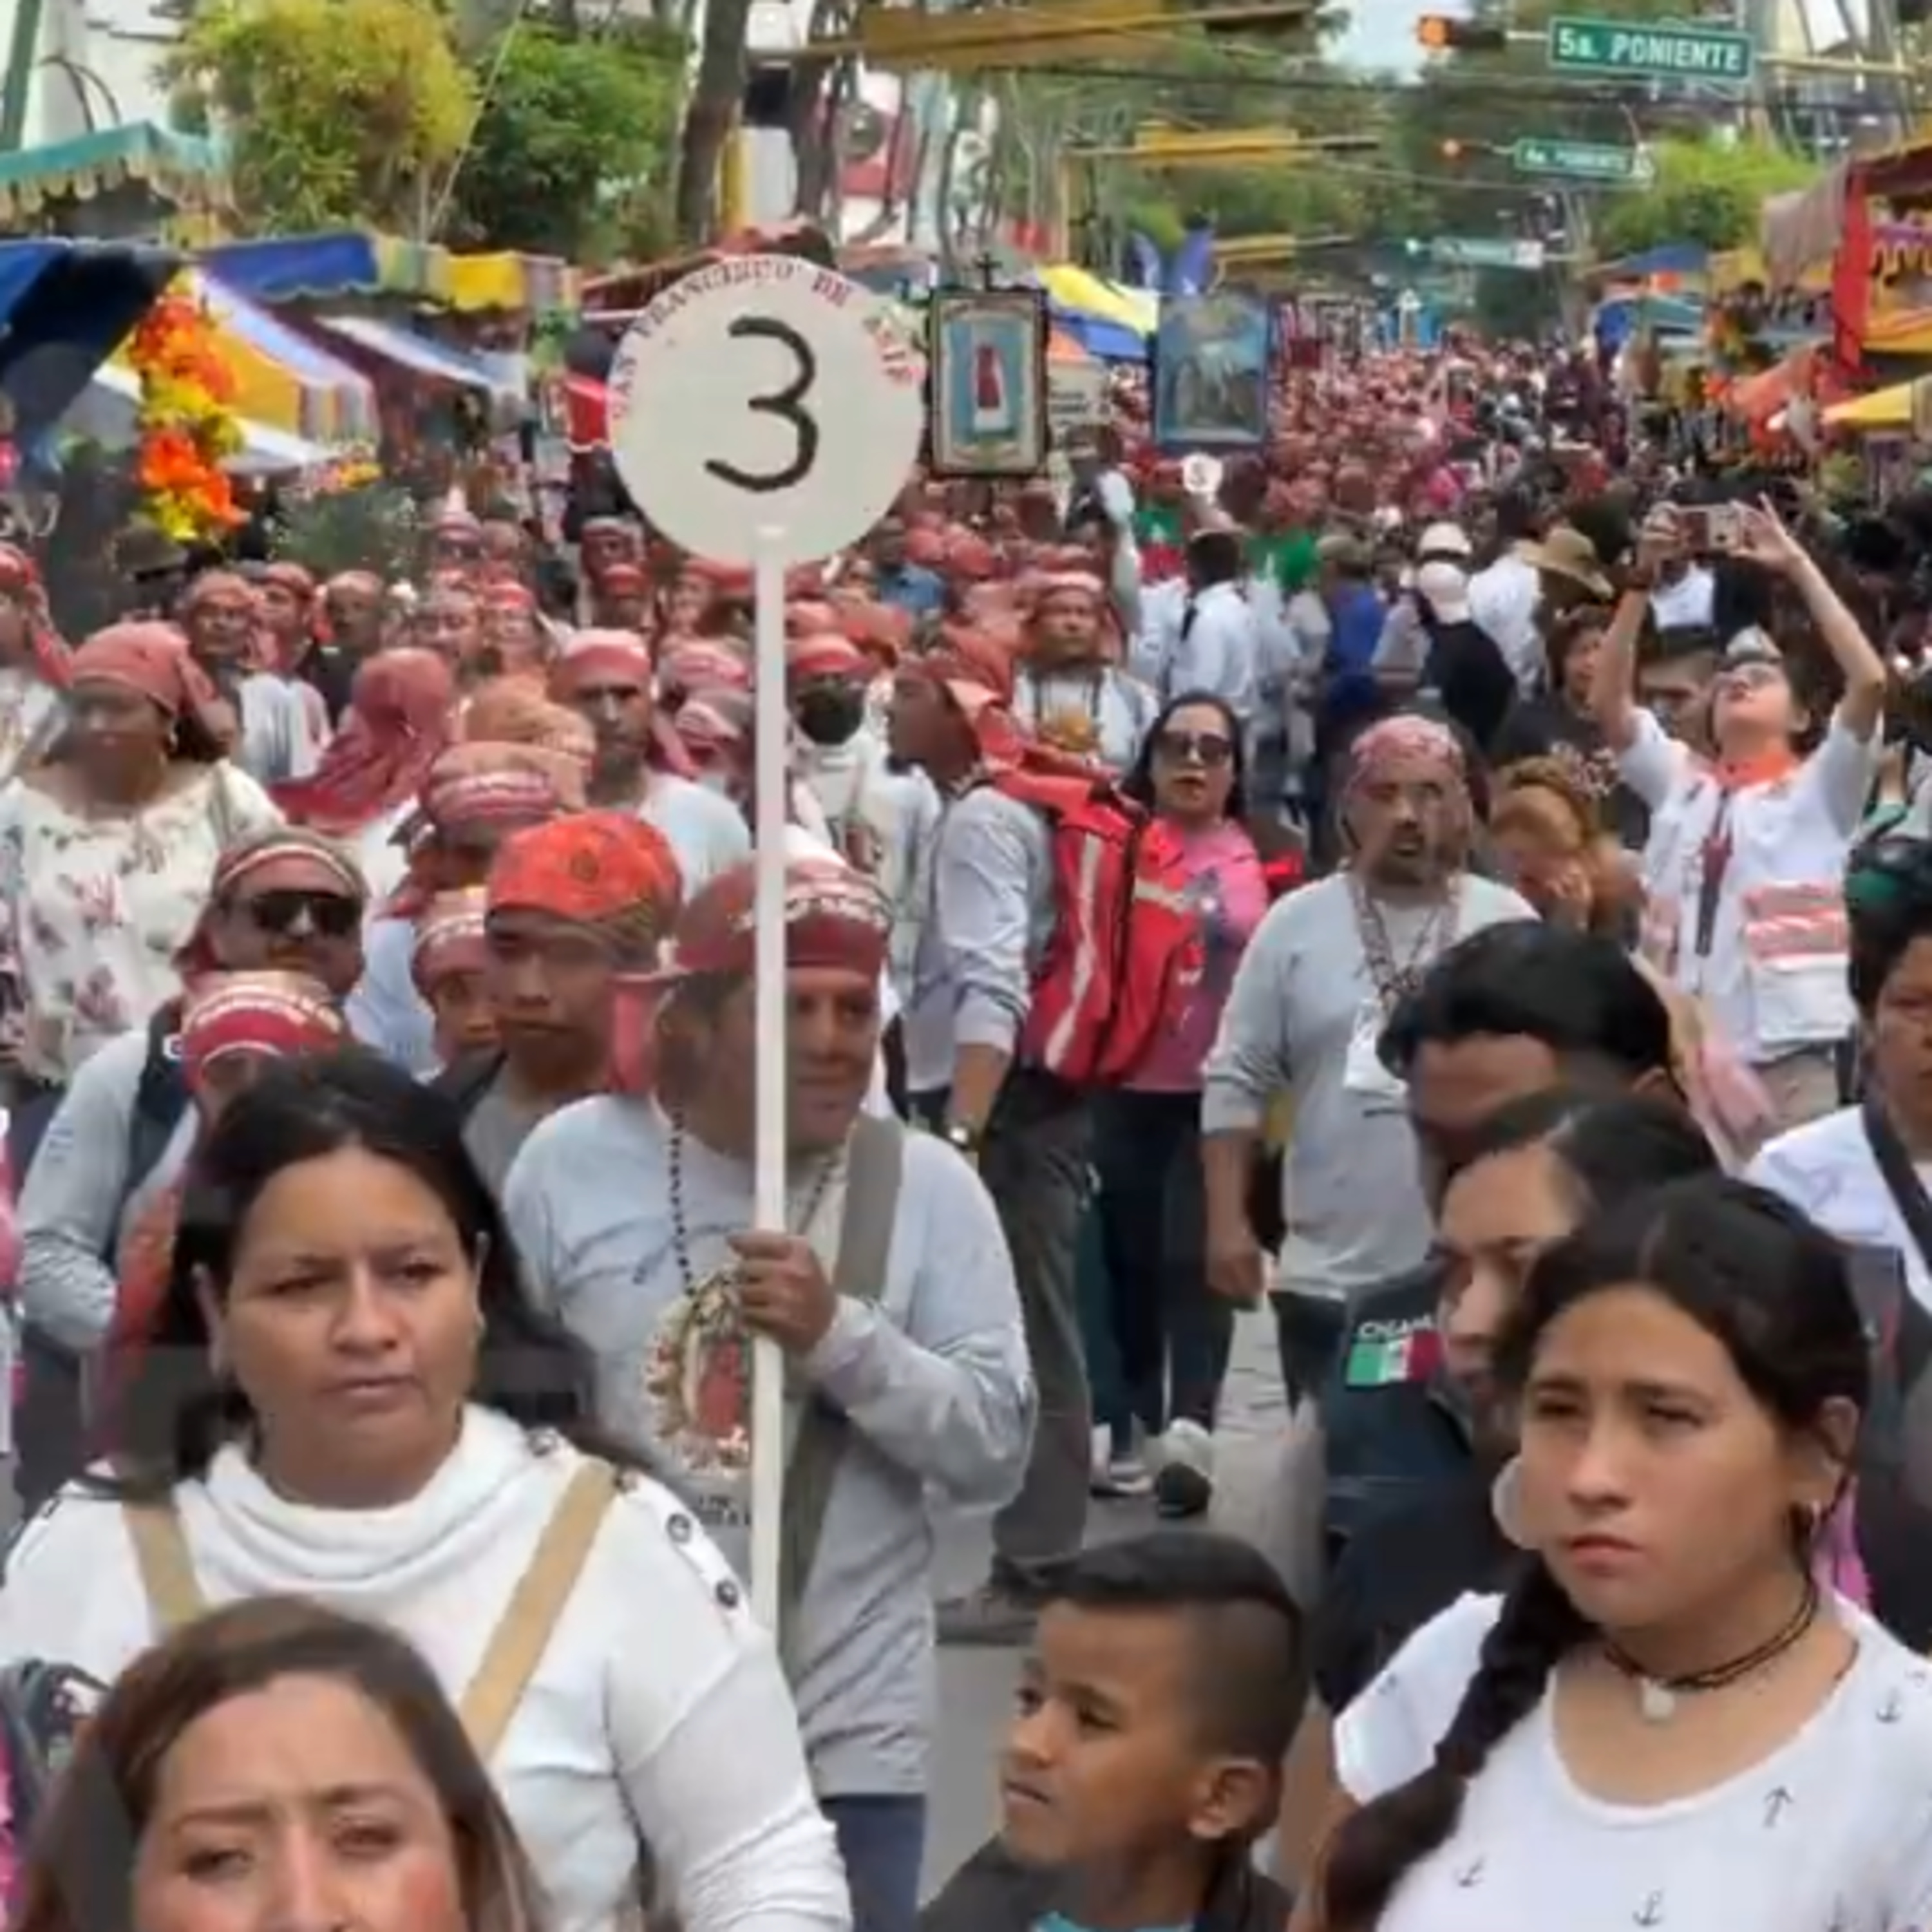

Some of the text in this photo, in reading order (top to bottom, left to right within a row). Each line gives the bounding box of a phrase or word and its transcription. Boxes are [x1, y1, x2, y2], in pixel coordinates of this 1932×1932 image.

[1609, 33, 1741, 71] PONIENTE
[609, 354, 638, 419] SAN
[813, 270, 851, 308] DE
[703, 316, 818, 493] 3
